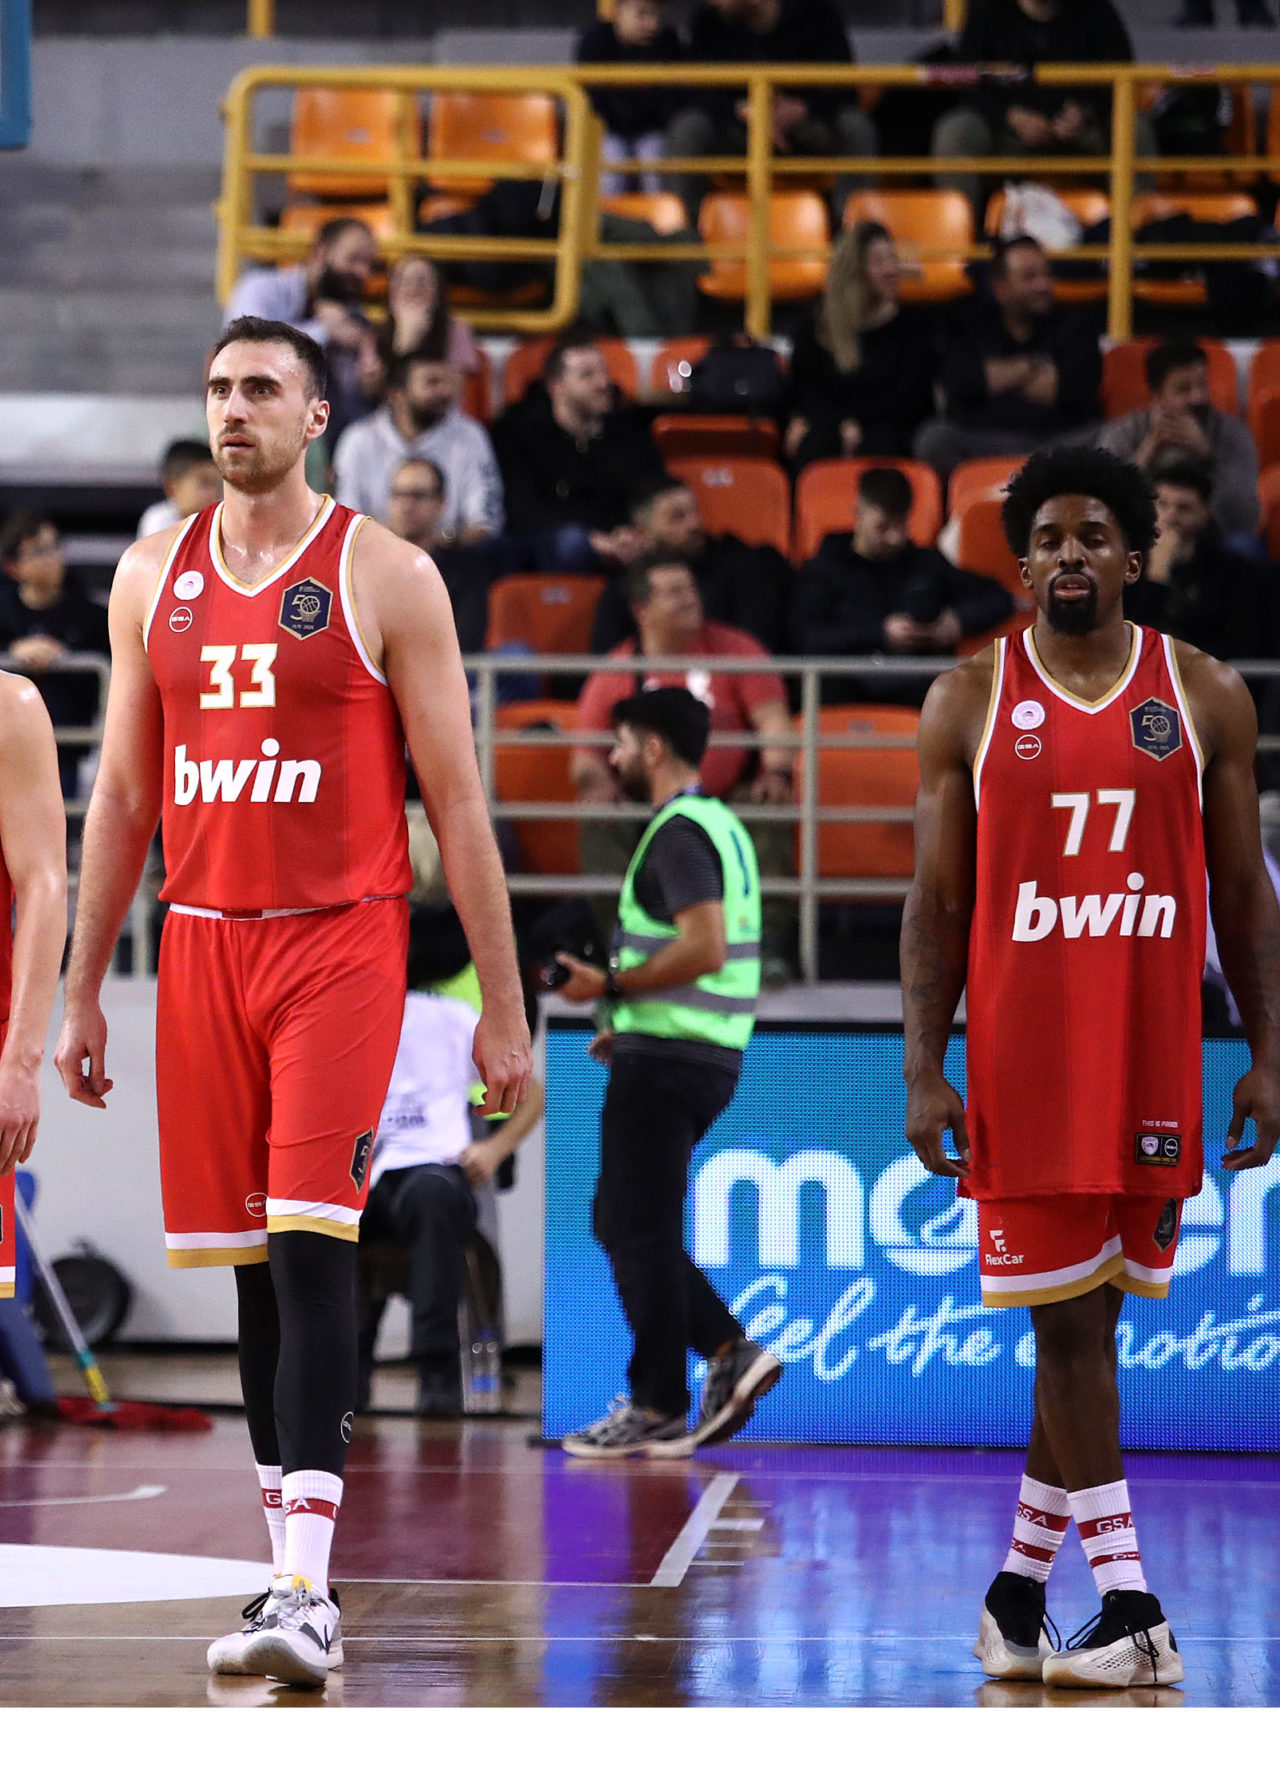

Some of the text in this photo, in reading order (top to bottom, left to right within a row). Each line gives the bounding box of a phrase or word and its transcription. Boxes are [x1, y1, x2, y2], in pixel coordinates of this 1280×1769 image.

[199, 643, 278, 709] 33
[174, 738, 322, 806] bwin
[1050, 788, 1136, 856] 77
[1012, 872, 1177, 942] bwin
[985, 1253, 1025, 1266] FlexCar
[865, 1296, 1008, 1378] the
